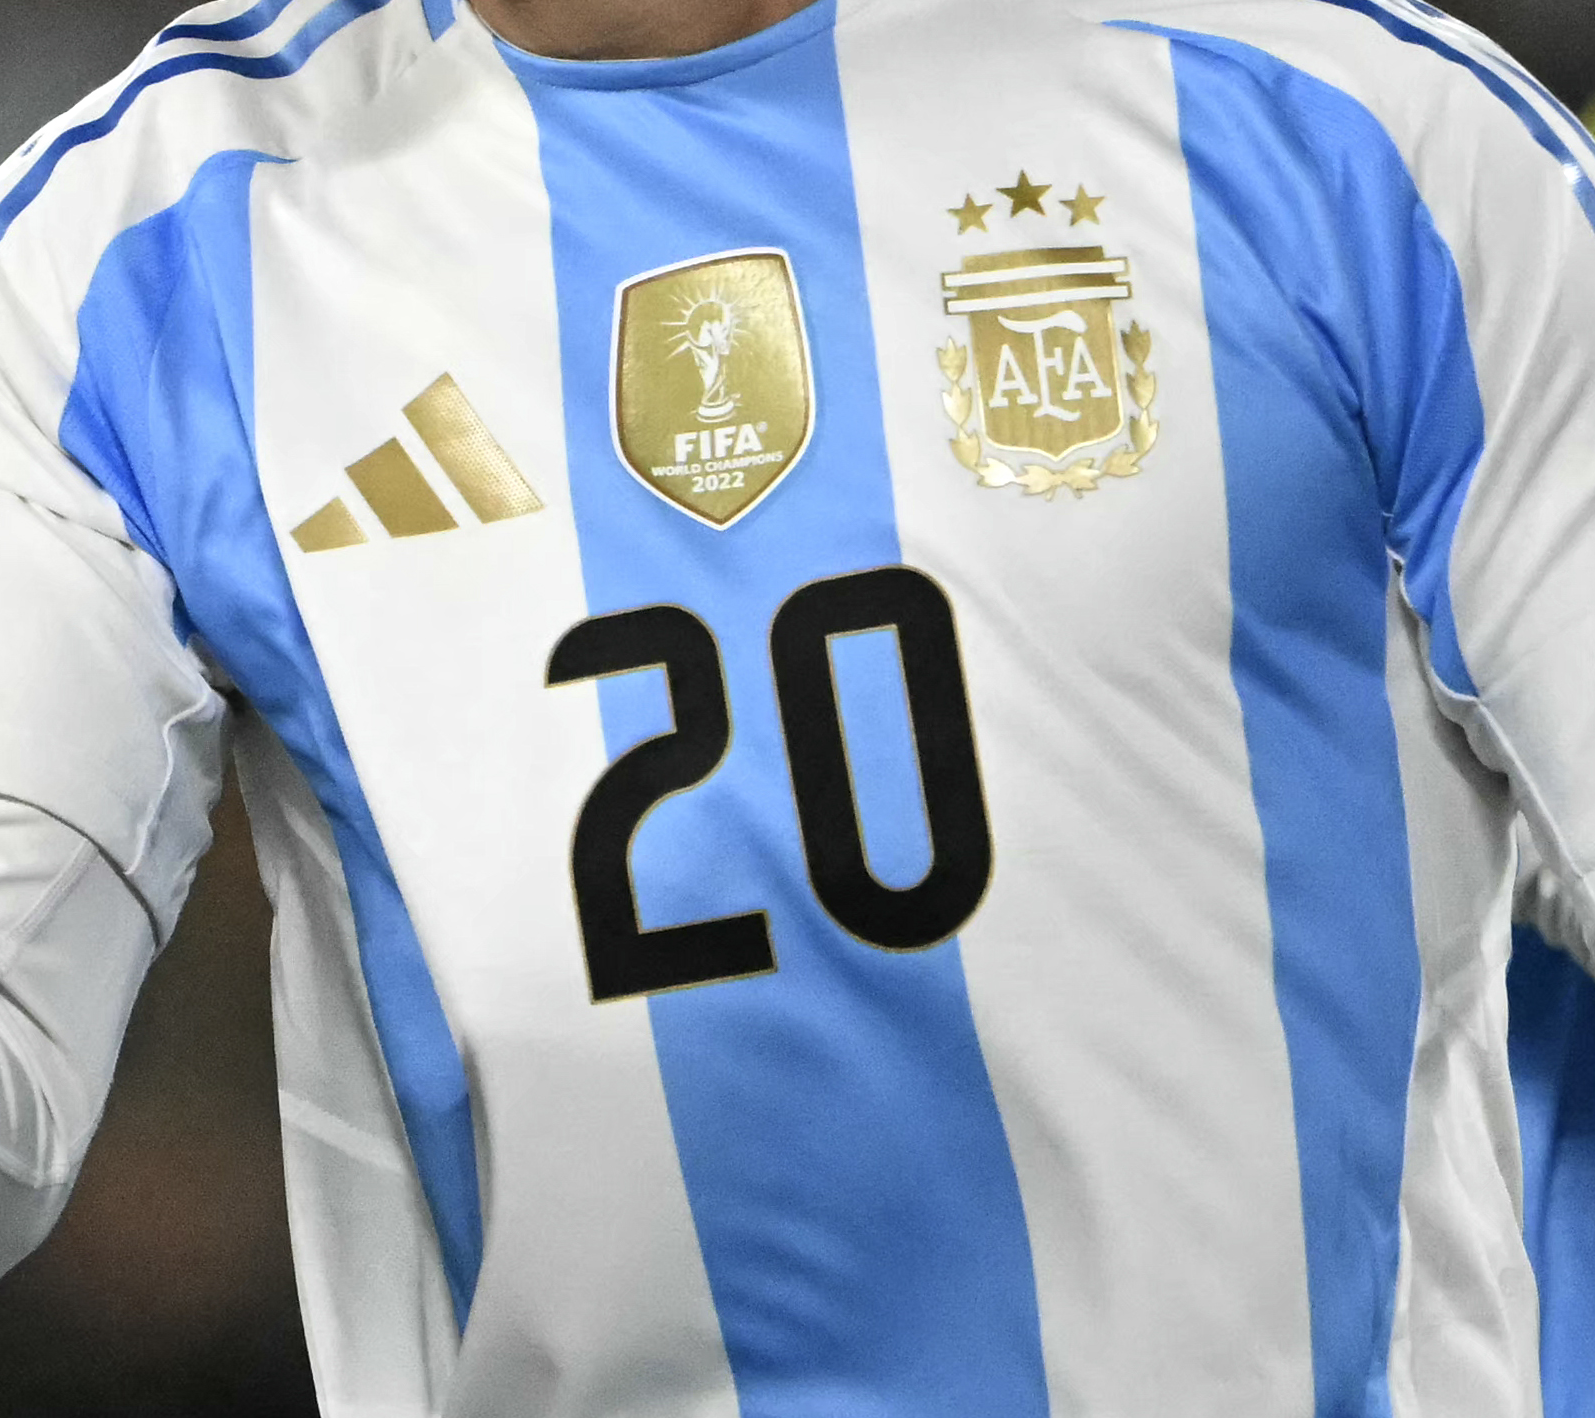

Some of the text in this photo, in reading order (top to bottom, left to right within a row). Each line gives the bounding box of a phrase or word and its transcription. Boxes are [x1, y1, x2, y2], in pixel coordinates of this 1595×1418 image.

[988, 309, 1112, 422] AFA
[651, 451, 784, 477] WORLD CHAMPIONS
[692, 471, 745, 493] 2022
[544, 562, 996, 1006] 20
